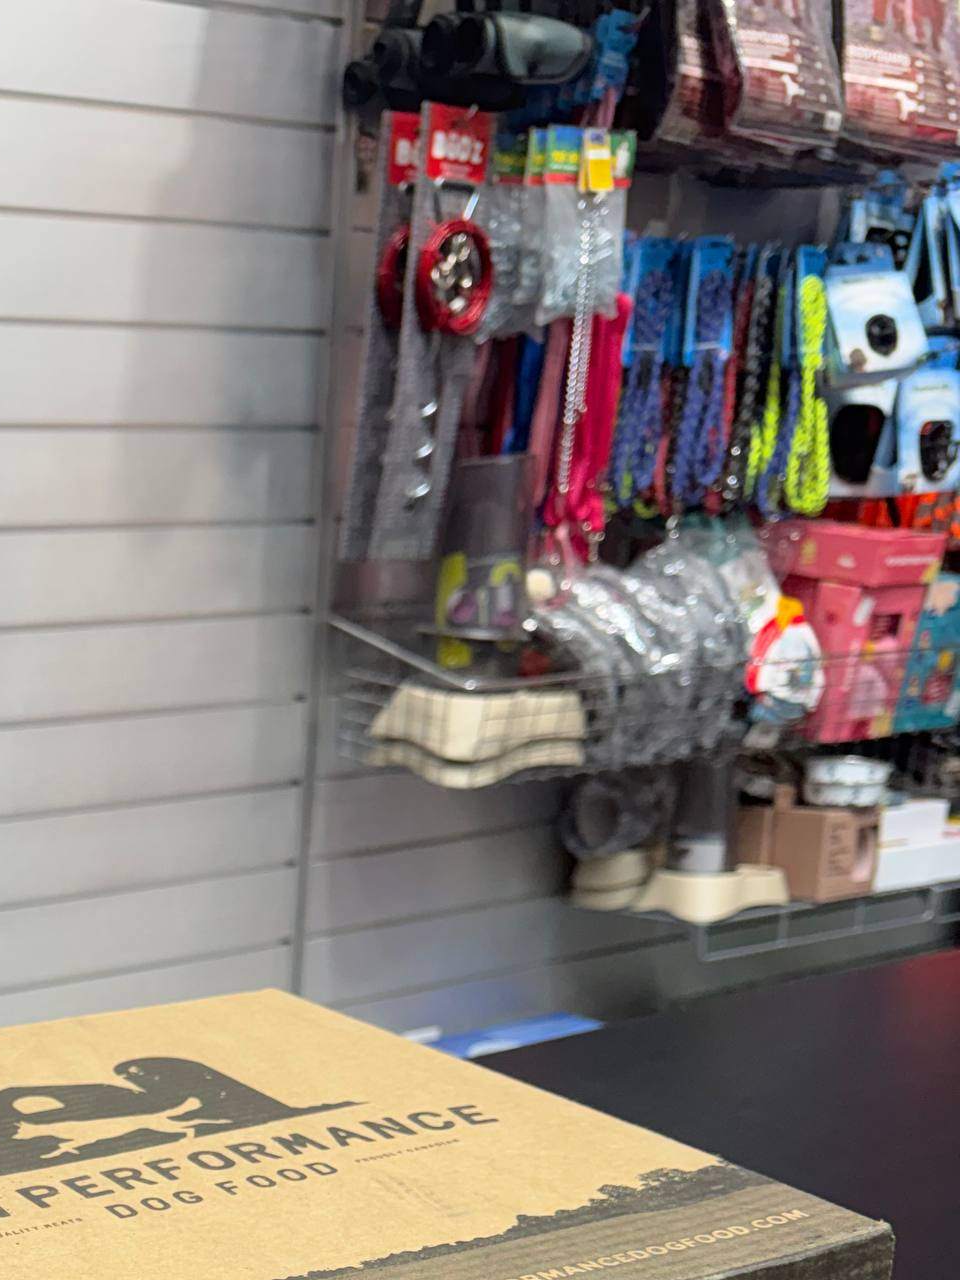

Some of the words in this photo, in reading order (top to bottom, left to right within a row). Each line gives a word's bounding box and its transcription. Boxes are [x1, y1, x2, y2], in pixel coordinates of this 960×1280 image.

[16, 1104, 501, 1208] PERFORMANCE
[105, 1189, 204, 1219] DOG
[221, 1161, 339, 1196] FOOD
